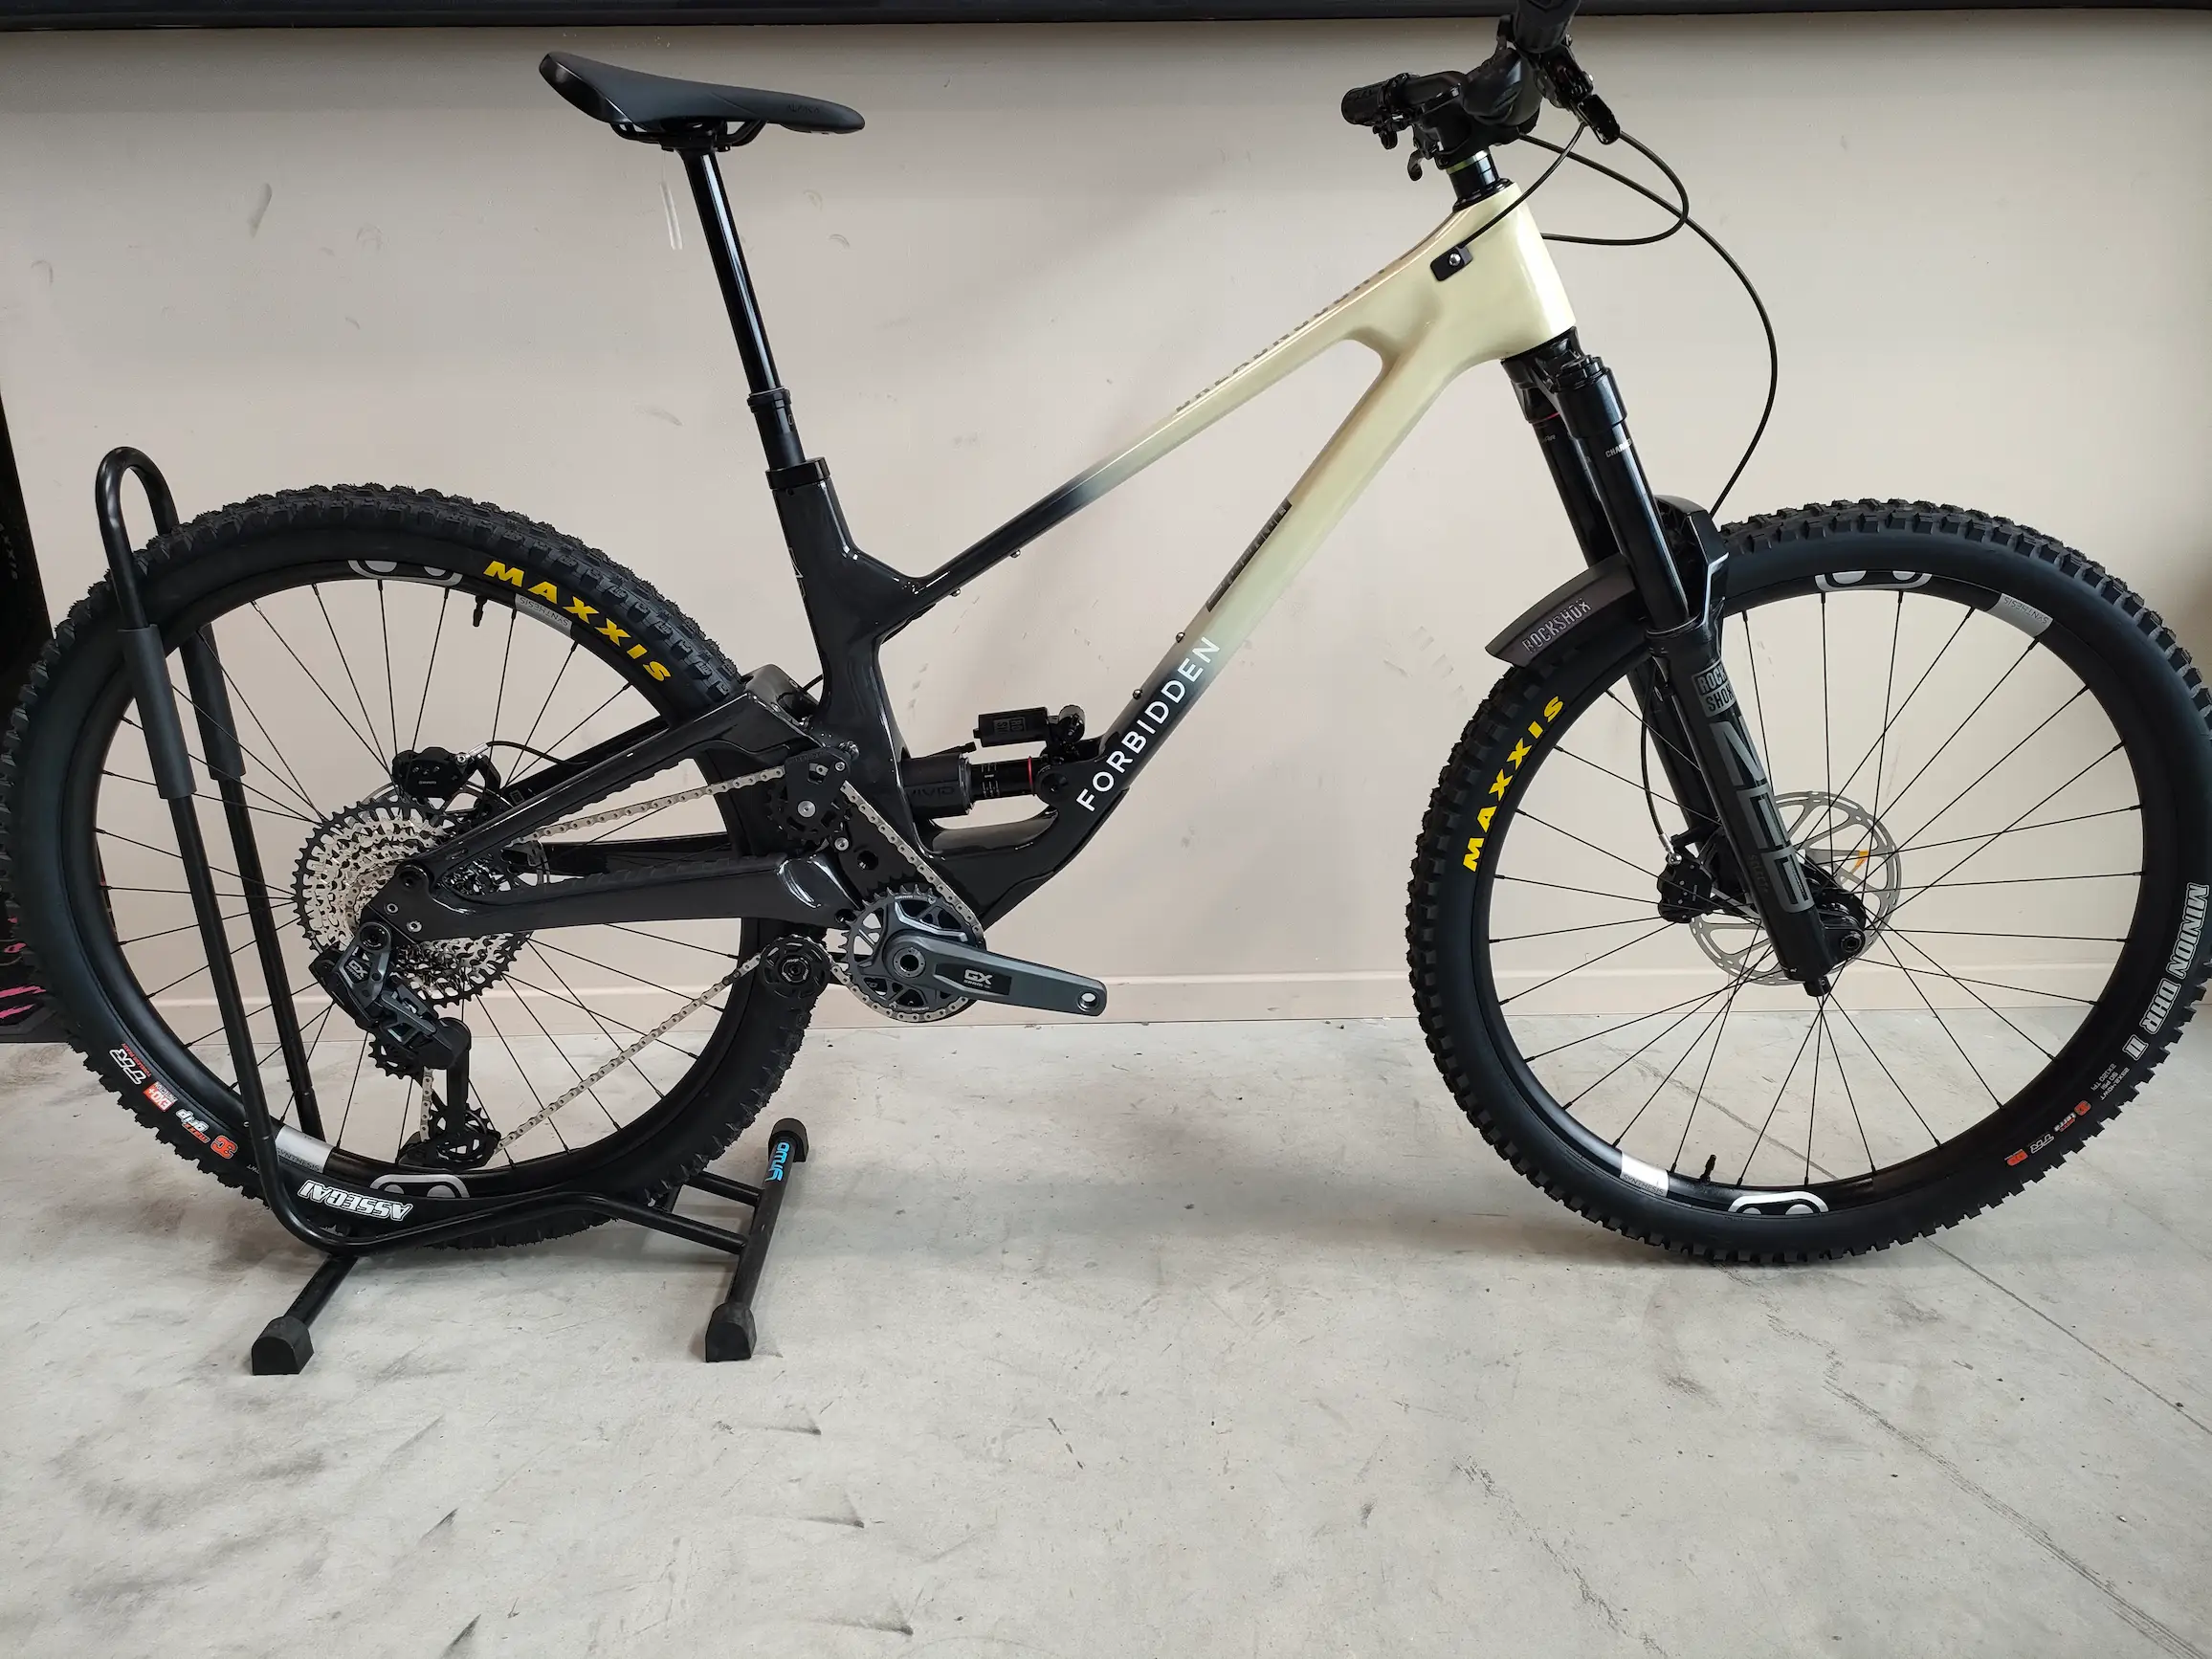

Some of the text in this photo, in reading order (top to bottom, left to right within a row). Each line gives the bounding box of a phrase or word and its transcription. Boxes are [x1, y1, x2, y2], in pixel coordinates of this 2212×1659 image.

[483, 561, 671, 681] MAXXIS
[520, 596, 569, 627] SYNTHESIS
[1522, 598, 1591, 653] ROCKSHOX
[2003, 596, 2049, 624] SYNTHESIS
[1075, 636, 1221, 812] FORBIDDEN
[1463, 696, 1563, 872] MAXXIS
[964, 968, 993, 985] GX
[2122, 882, 2209, 1061] MINION DHR II
[109, 1048, 146, 1085] TR
[176, 1109, 209, 1133] grip
[210, 1135, 238, 1159] 3C
[2030, 1133, 2055, 1154] TR
[297, 1179, 413, 1222] ASSEGAI
[1623, 1174, 1664, 1195] SYNTHESIS
